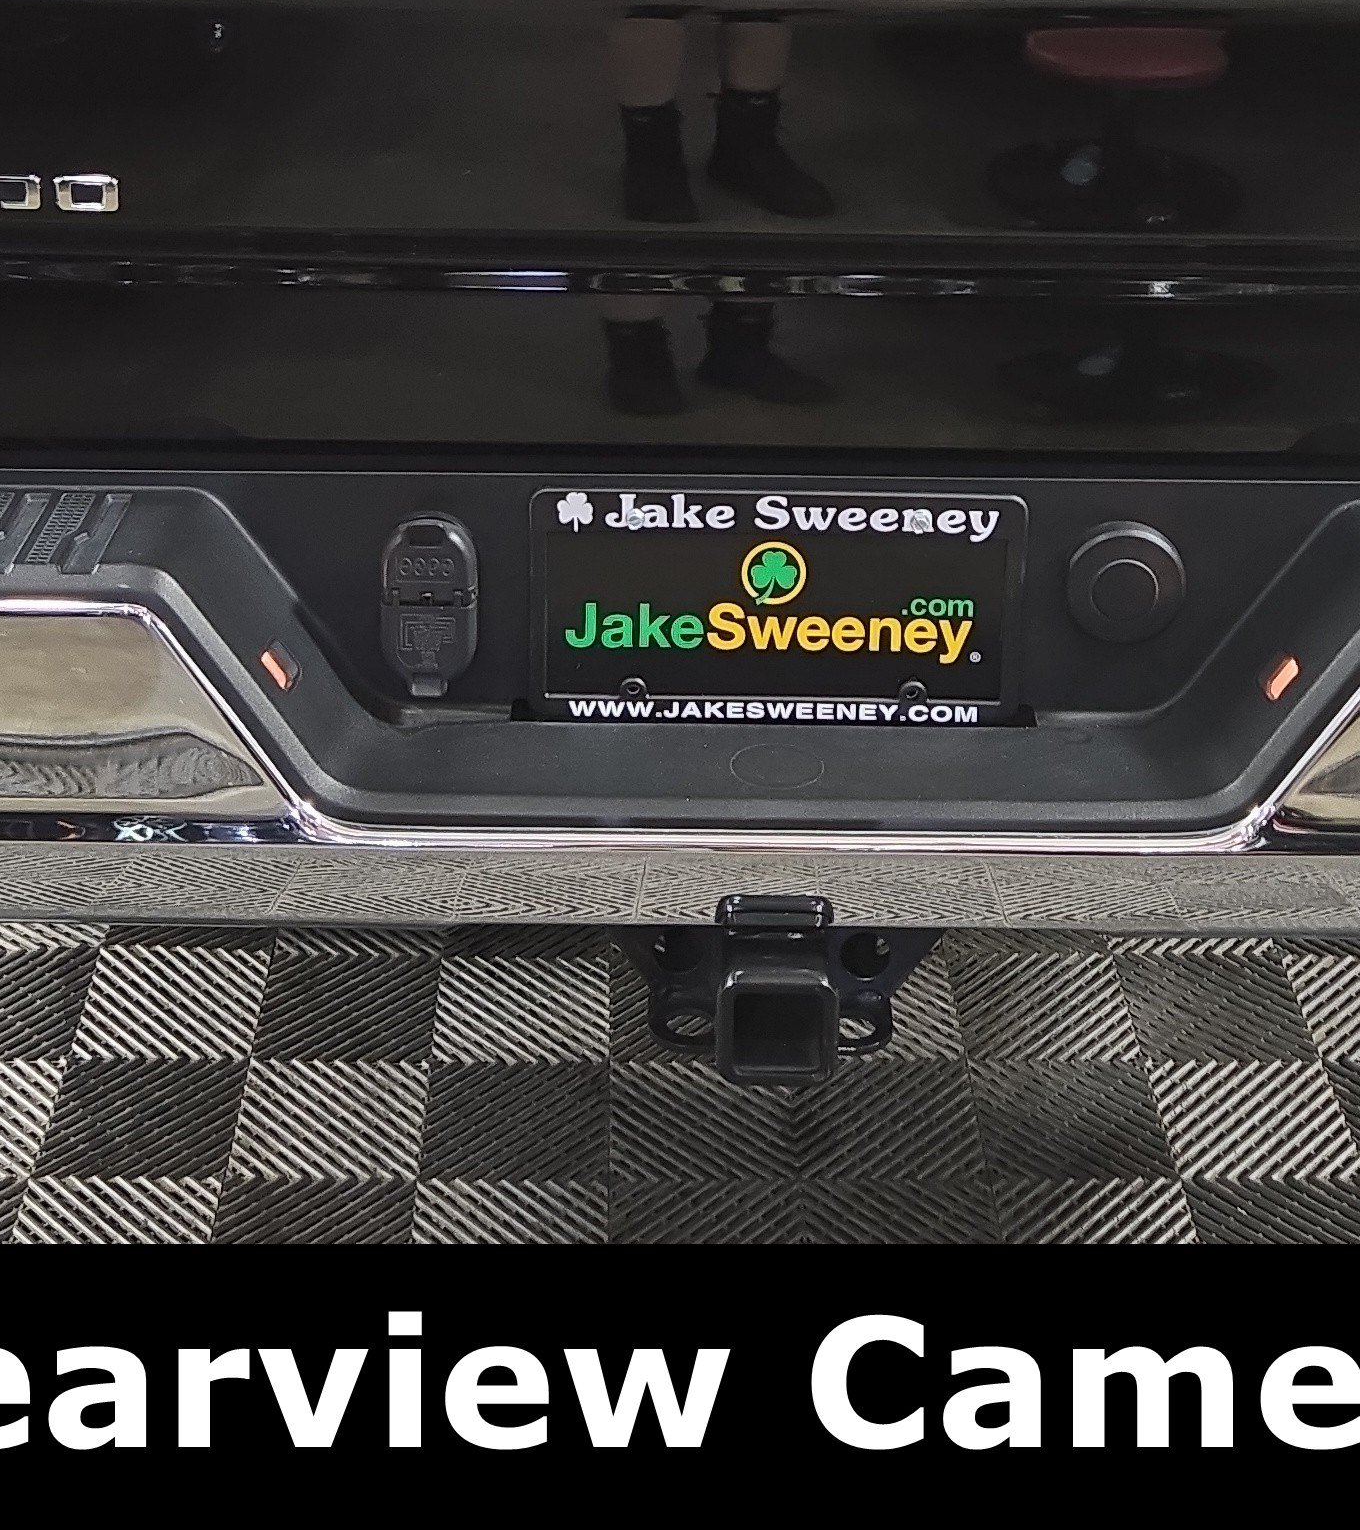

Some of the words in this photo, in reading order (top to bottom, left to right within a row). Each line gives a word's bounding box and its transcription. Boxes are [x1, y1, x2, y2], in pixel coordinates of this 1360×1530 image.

[605, 492, 736, 531] Jake
[754, 494, 1000, 543] Sweeney
[568, 699, 979, 724] WWW.JAKESWEENEY.COM
